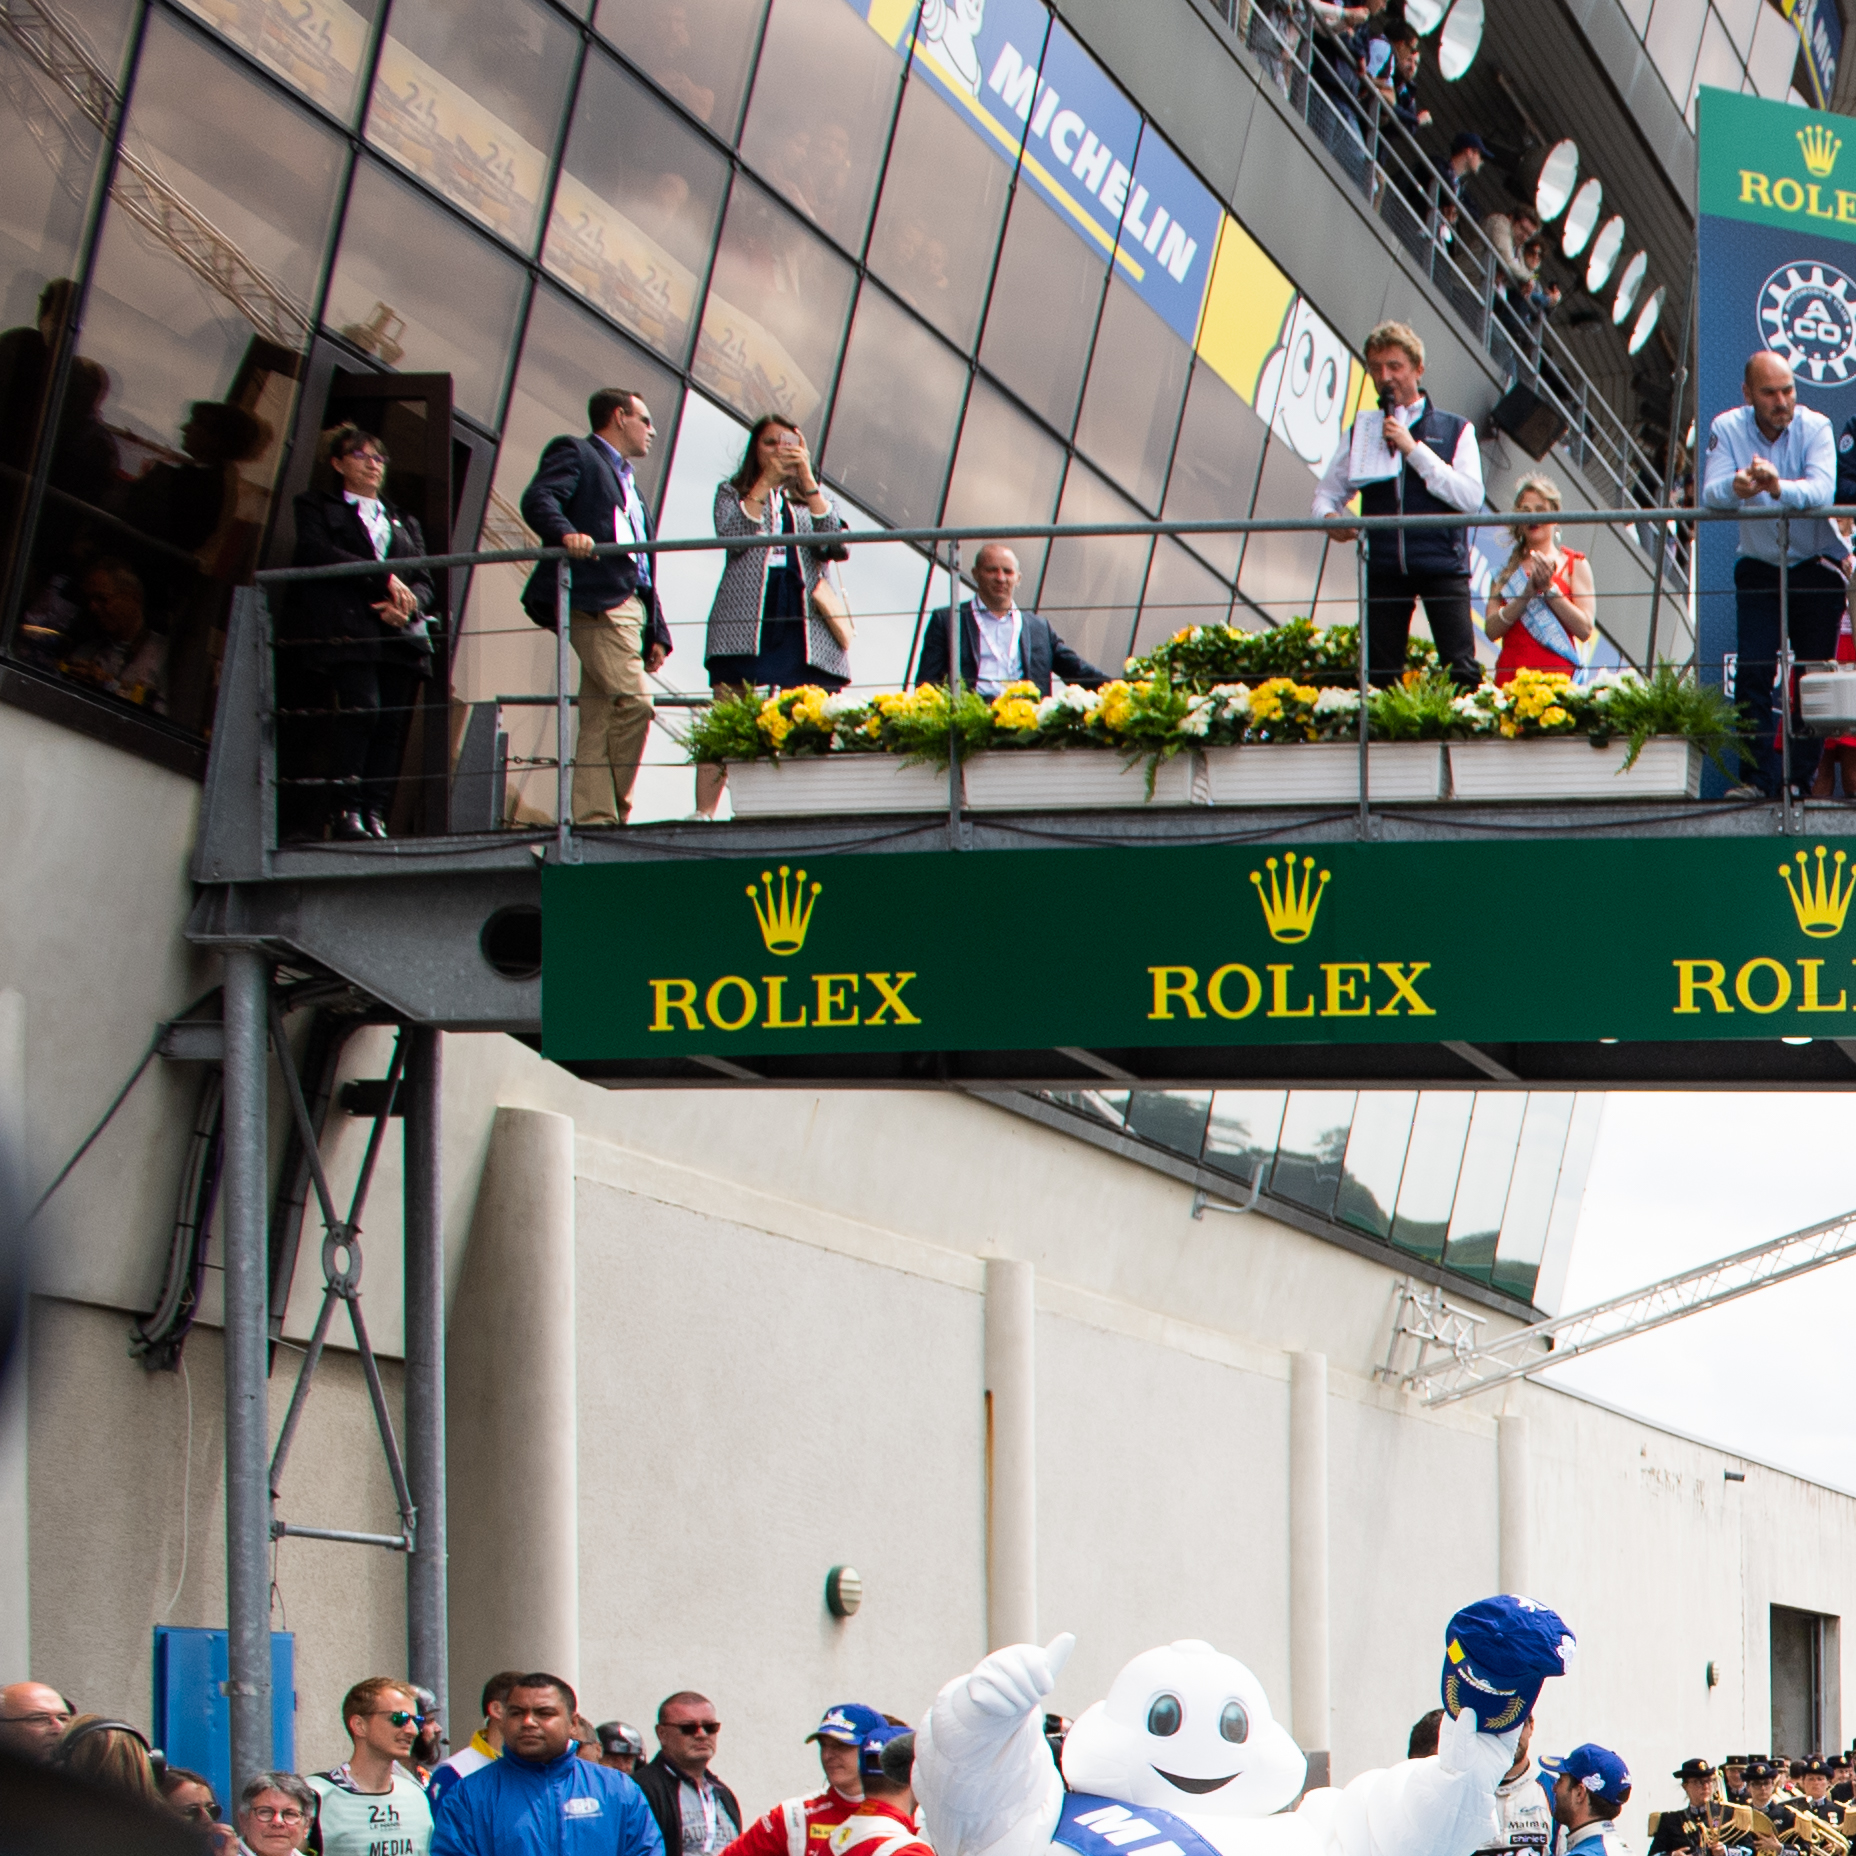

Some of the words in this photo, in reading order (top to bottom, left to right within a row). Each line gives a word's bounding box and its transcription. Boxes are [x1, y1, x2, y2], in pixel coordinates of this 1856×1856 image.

[988, 40, 1198, 284] MICHELIN
[649, 970, 920, 1032] ROLEX
[1148, 961, 1436, 1020] ROLEX
[1512, 1834, 1546, 1844] thiriet
